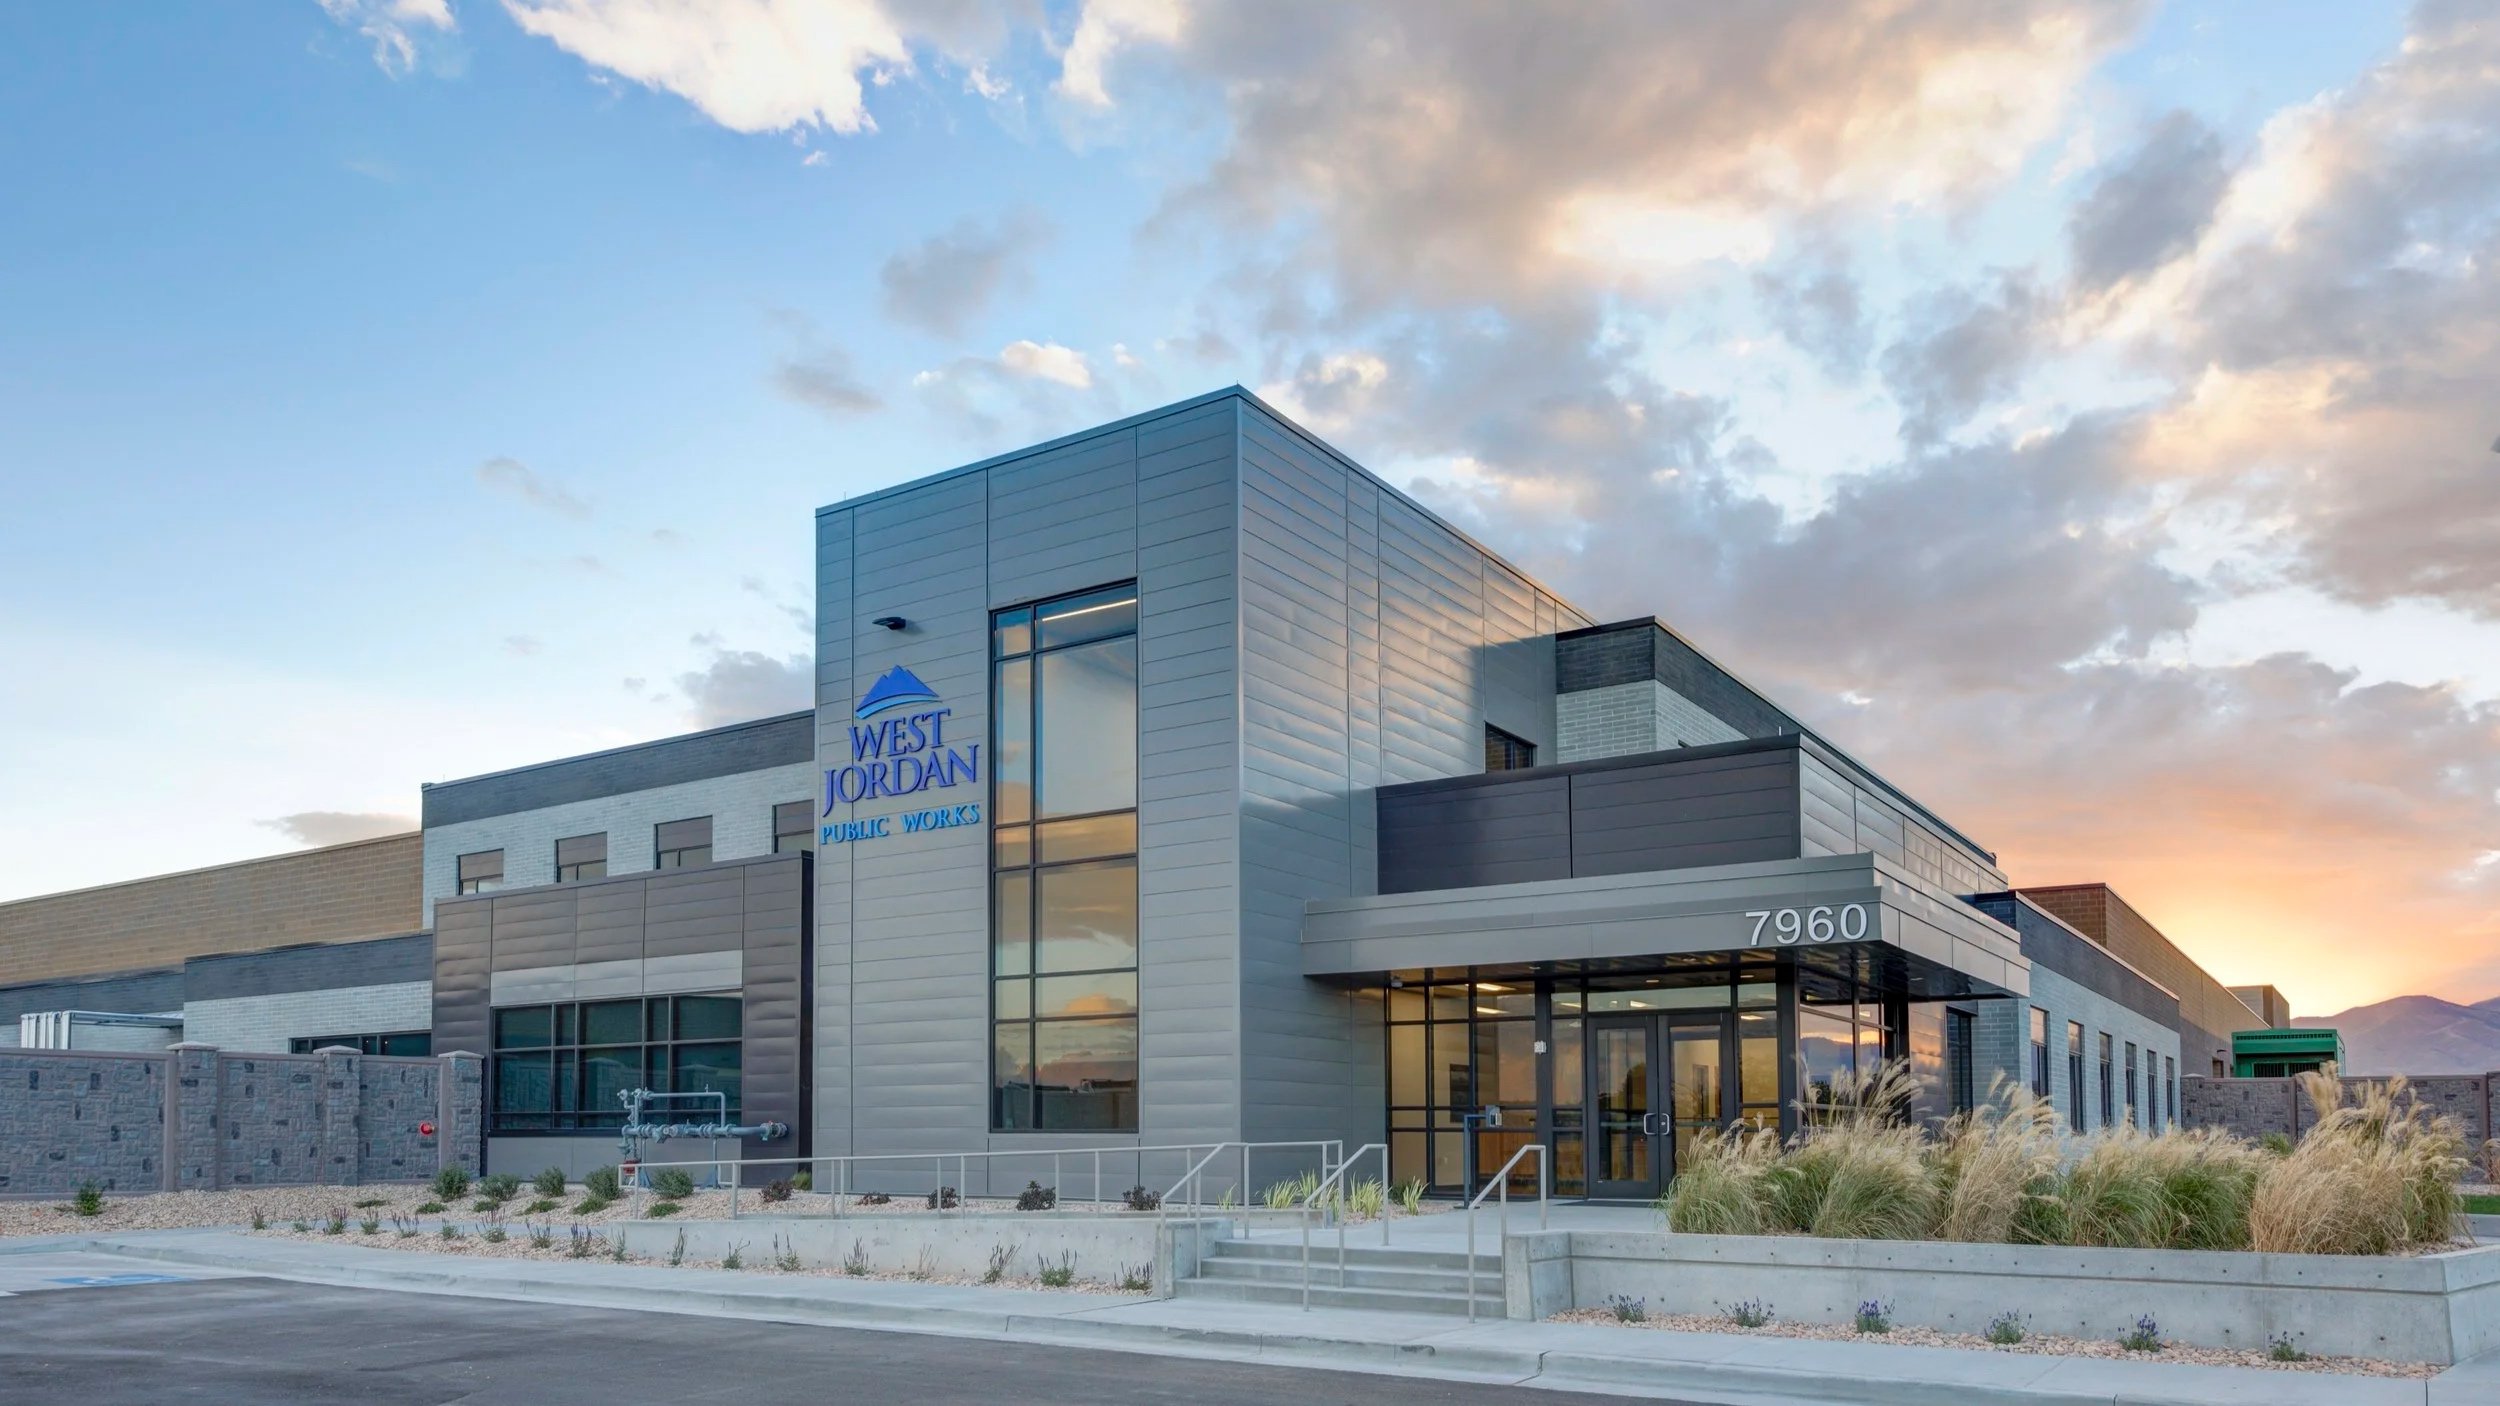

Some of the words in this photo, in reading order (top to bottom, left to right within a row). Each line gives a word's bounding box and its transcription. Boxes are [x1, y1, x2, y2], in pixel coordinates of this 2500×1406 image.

[848, 708, 951, 762] WEST
[822, 744, 979, 818] JORDAN
[821, 817, 890, 845] PUBLIC
[901, 804, 980, 833] WORKS
[1745, 903, 1868, 946] 7960
